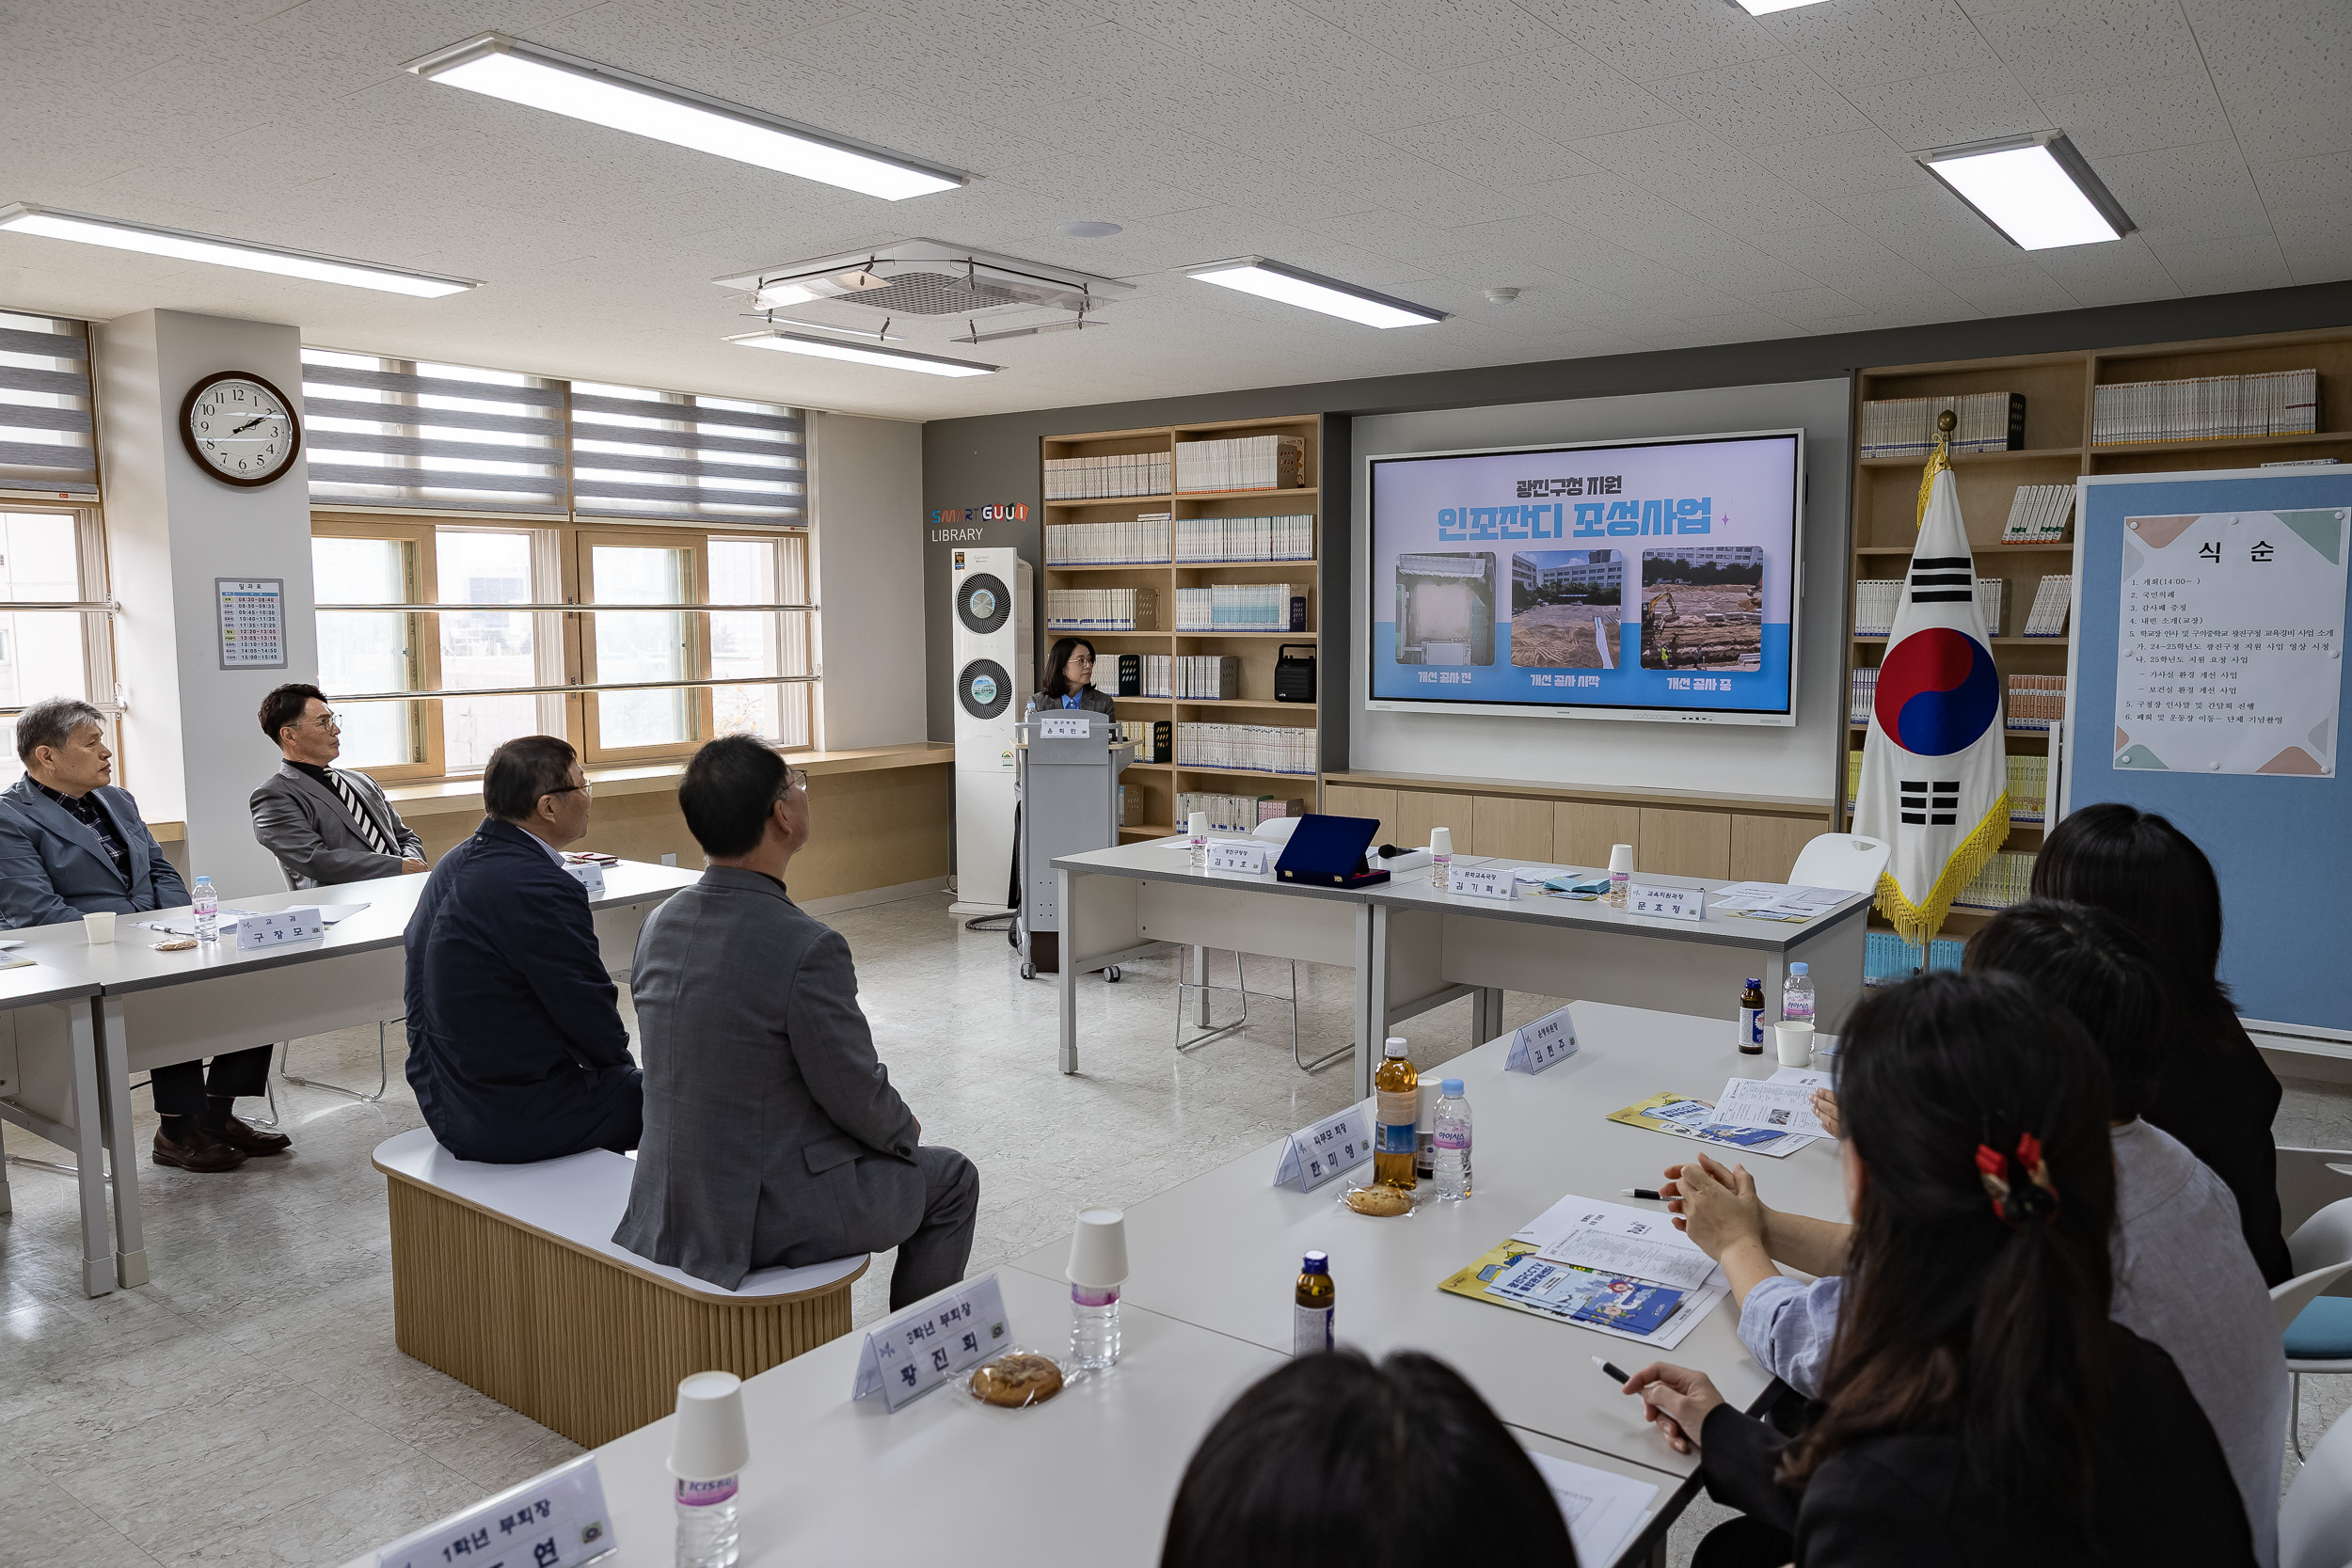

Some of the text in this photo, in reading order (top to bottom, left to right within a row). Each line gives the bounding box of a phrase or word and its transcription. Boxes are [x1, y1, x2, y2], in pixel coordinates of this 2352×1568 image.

[215, 392, 225, 404] 11
[232, 389, 245, 401] 12
[253, 395, 258, 406] 1
[202, 404, 215, 416] 10
[200, 421, 209, 433] 9
[270, 426, 278, 438] 3
[206, 437, 215, 450] 8
[265, 444, 274, 454] 4
[220, 452, 228, 464] 7
[238, 458, 246, 469] 6
[256, 454, 265, 466] 5
[1516, 475, 1622, 499] 광진구청 지원
[931, 505, 1024, 523] SMART GUUI
[1438, 497, 1711, 542] 인조잔디 조성사업
[931, 528, 983, 542] LIBRARY
[2142, 591, 2175, 599] 국민의례
[2142, 604, 2166, 612] 감사패
[2140, 629, 2161, 638] 학교장
[2182, 629, 2189, 638] 및
[2232, 629, 2262, 638] 광진구청
[2297, 629, 2314, 638] 사업
[2316, 628, 2334, 638] 소개
[2206, 642, 2240, 651] 광진구청
[2245, 642, 2262, 651] 지원
[2265, 642, 2283, 651] 사업
[2289, 642, 2307, 651] 영상
[2312, 642, 2329, 651] 시청
[2150, 656, 2185, 664] 25학년도
[2189, 656, 2205, 664] 지원
[2210, 656, 2227, 664] 요청
[2231, 656, 2249, 664] 사업
[1417, 671, 1438, 684] 개선
[1439, 672, 1460, 684] 공사
[1530, 673, 1600, 688] 개선 공사 시작
[2150, 671, 2174, 679] 가사실
[2179, 671, 2195, 679] 환경
[2200, 671, 2217, 679] 개선
[2220, 671, 2237, 679] 사업
[1666, 676, 1732, 691] 개선 공사 중
[2149, 686, 2173, 694] 보건실
[2178, 686, 2195, 694] 환경
[2199, 687, 2216, 695] 개선
[2219, 686, 2237, 695] 사업
[2137, 700, 2162, 709] 구청장
[2166, 701, 2190, 709] 인사말
[2195, 701, 2202, 709] 및
[2208, 702, 2233, 710] 간담회
[2238, 702, 2255, 710] 진행
[2137, 713, 2153, 721] 폐회
[2157, 713, 2165, 721] 및
[2169, 714, 2194, 722] 운동장
[2227, 715, 2244, 723] 단체
[2249, 715, 2283, 724] 기념촬영
[1646, 890, 1684, 900] 교육지원과장
[1313, 1122, 1347, 1147] 학부모 회장
[905, 1301, 972, 1345] 3학년 부회장
[441, 1498, 551, 1563] 1학년 부회장
